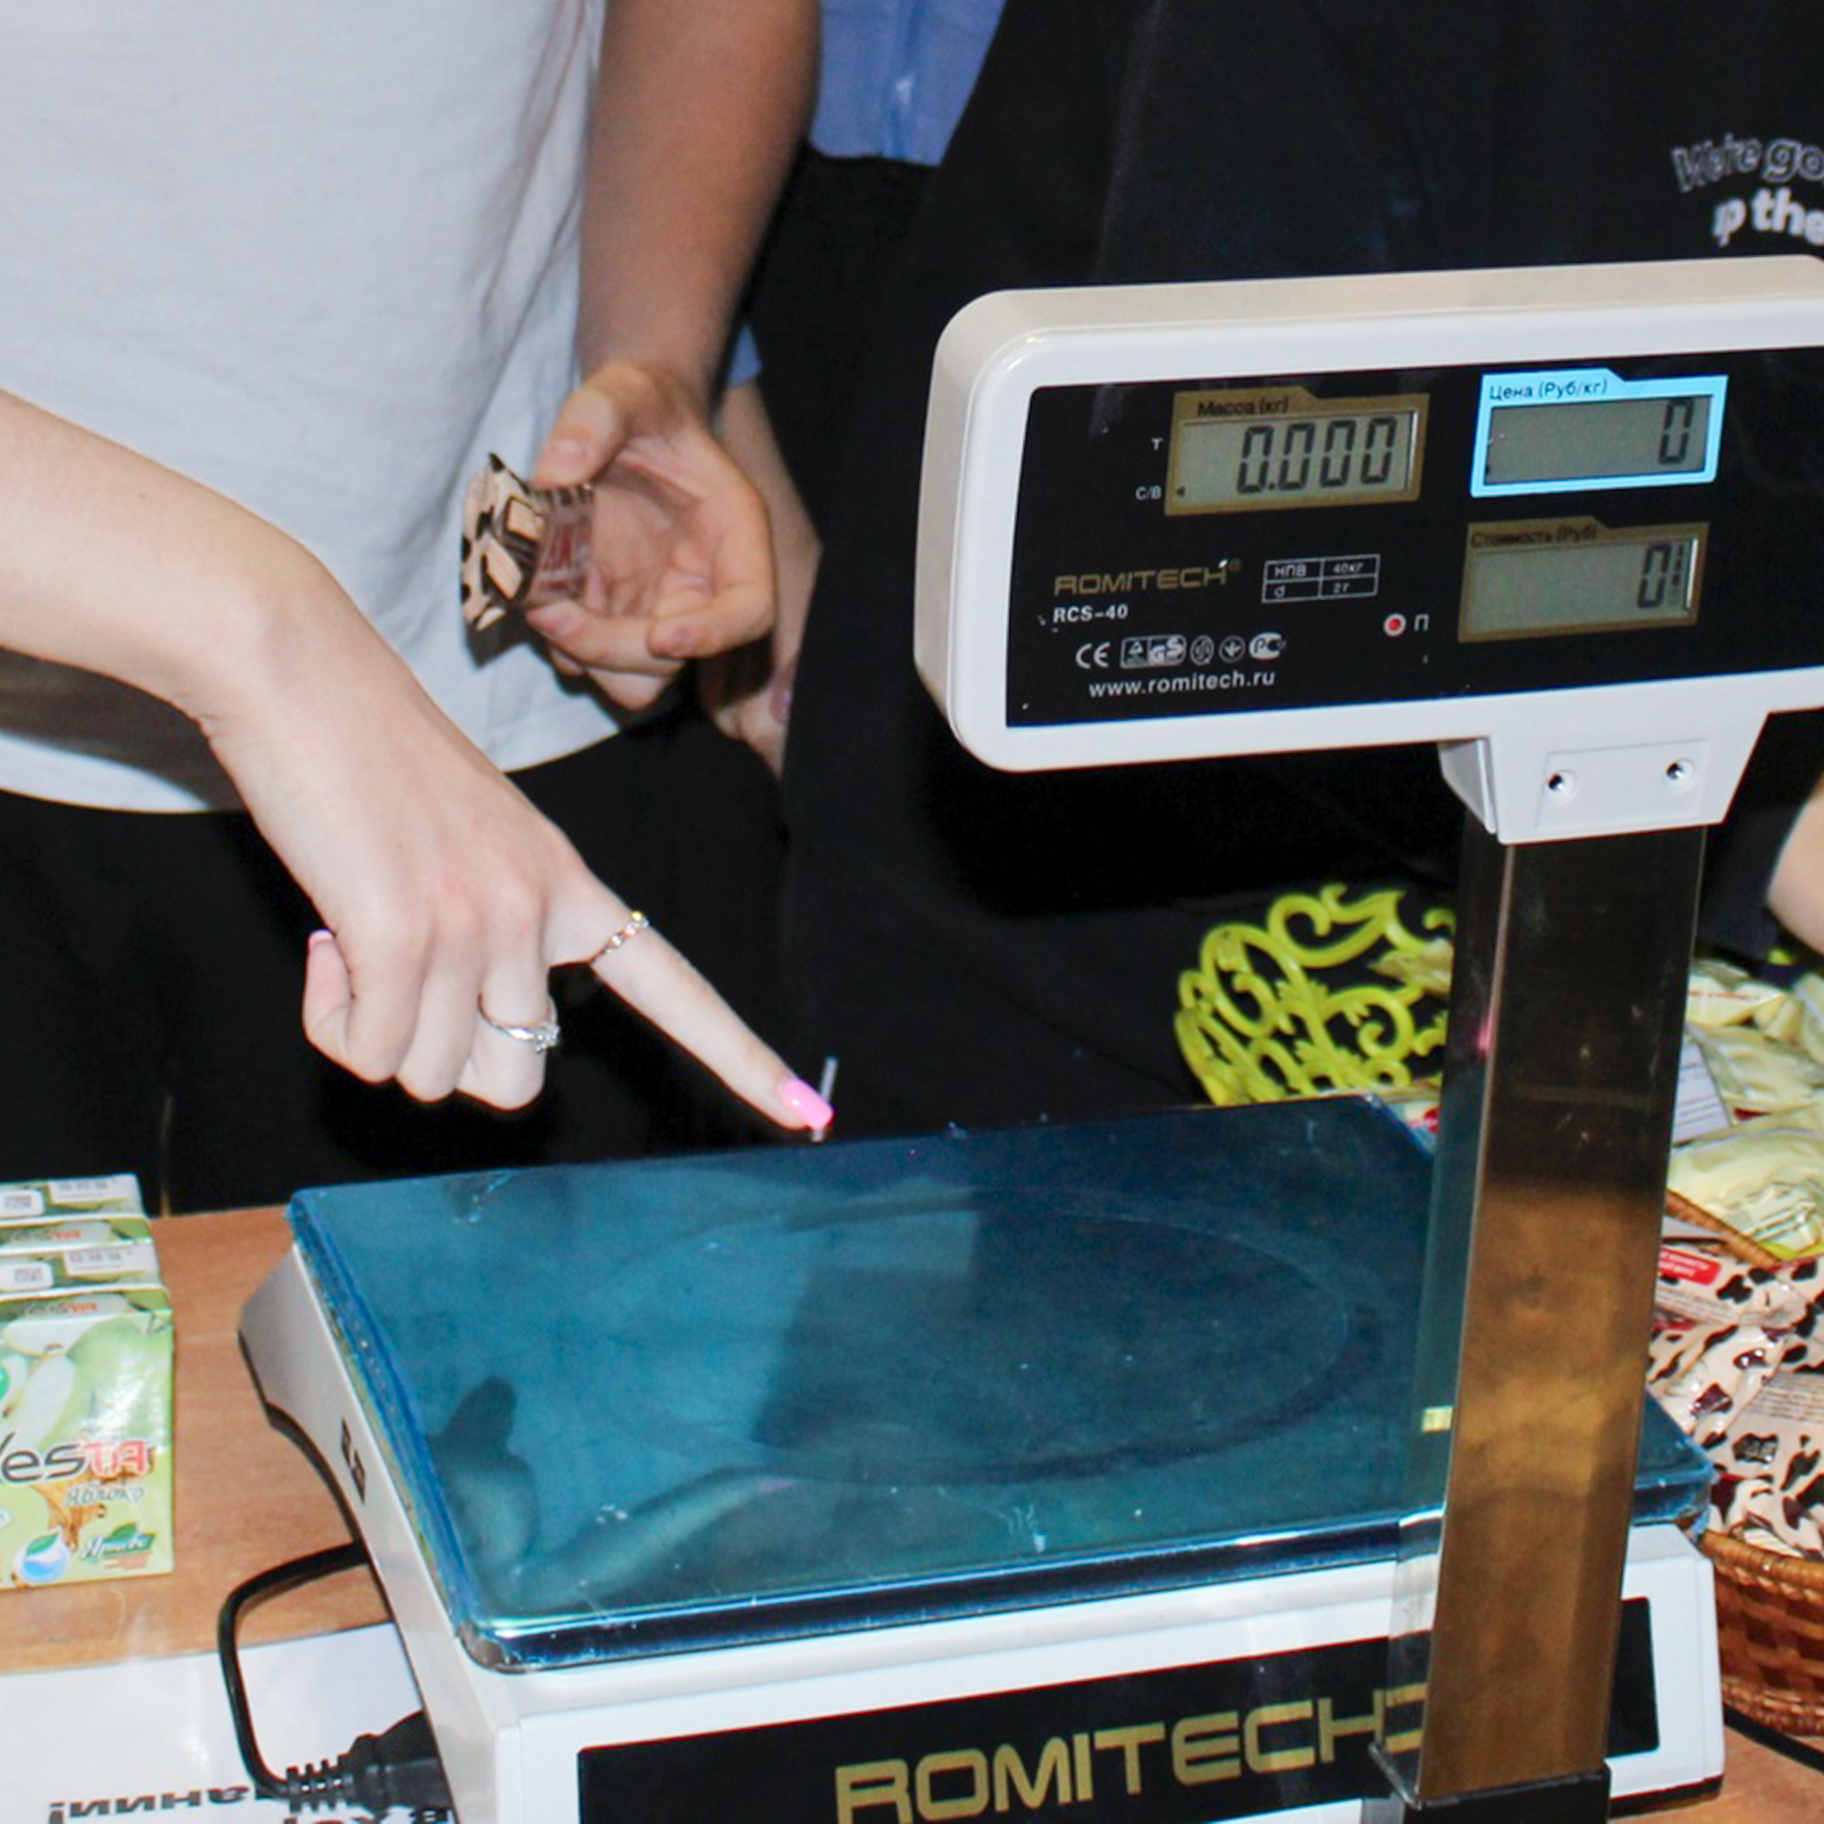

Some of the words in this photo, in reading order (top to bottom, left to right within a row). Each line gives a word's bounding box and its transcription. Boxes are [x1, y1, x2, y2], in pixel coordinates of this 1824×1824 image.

[1490, 384, 1533, 401] Цена
[1197, 401, 1255, 417] Масса
[1658, 398, 1694, 465] 0
[1237, 417, 1397, 494] 0.000
[1053, 567, 1227, 596] ROMITECH
[1637, 543, 1672, 609] 0
[1053, 604, 1128, 624] RCS-40
[1088, 670, 1276, 699] www.romitech.ru
[835, 1689, 1385, 1824] ROMITECH
